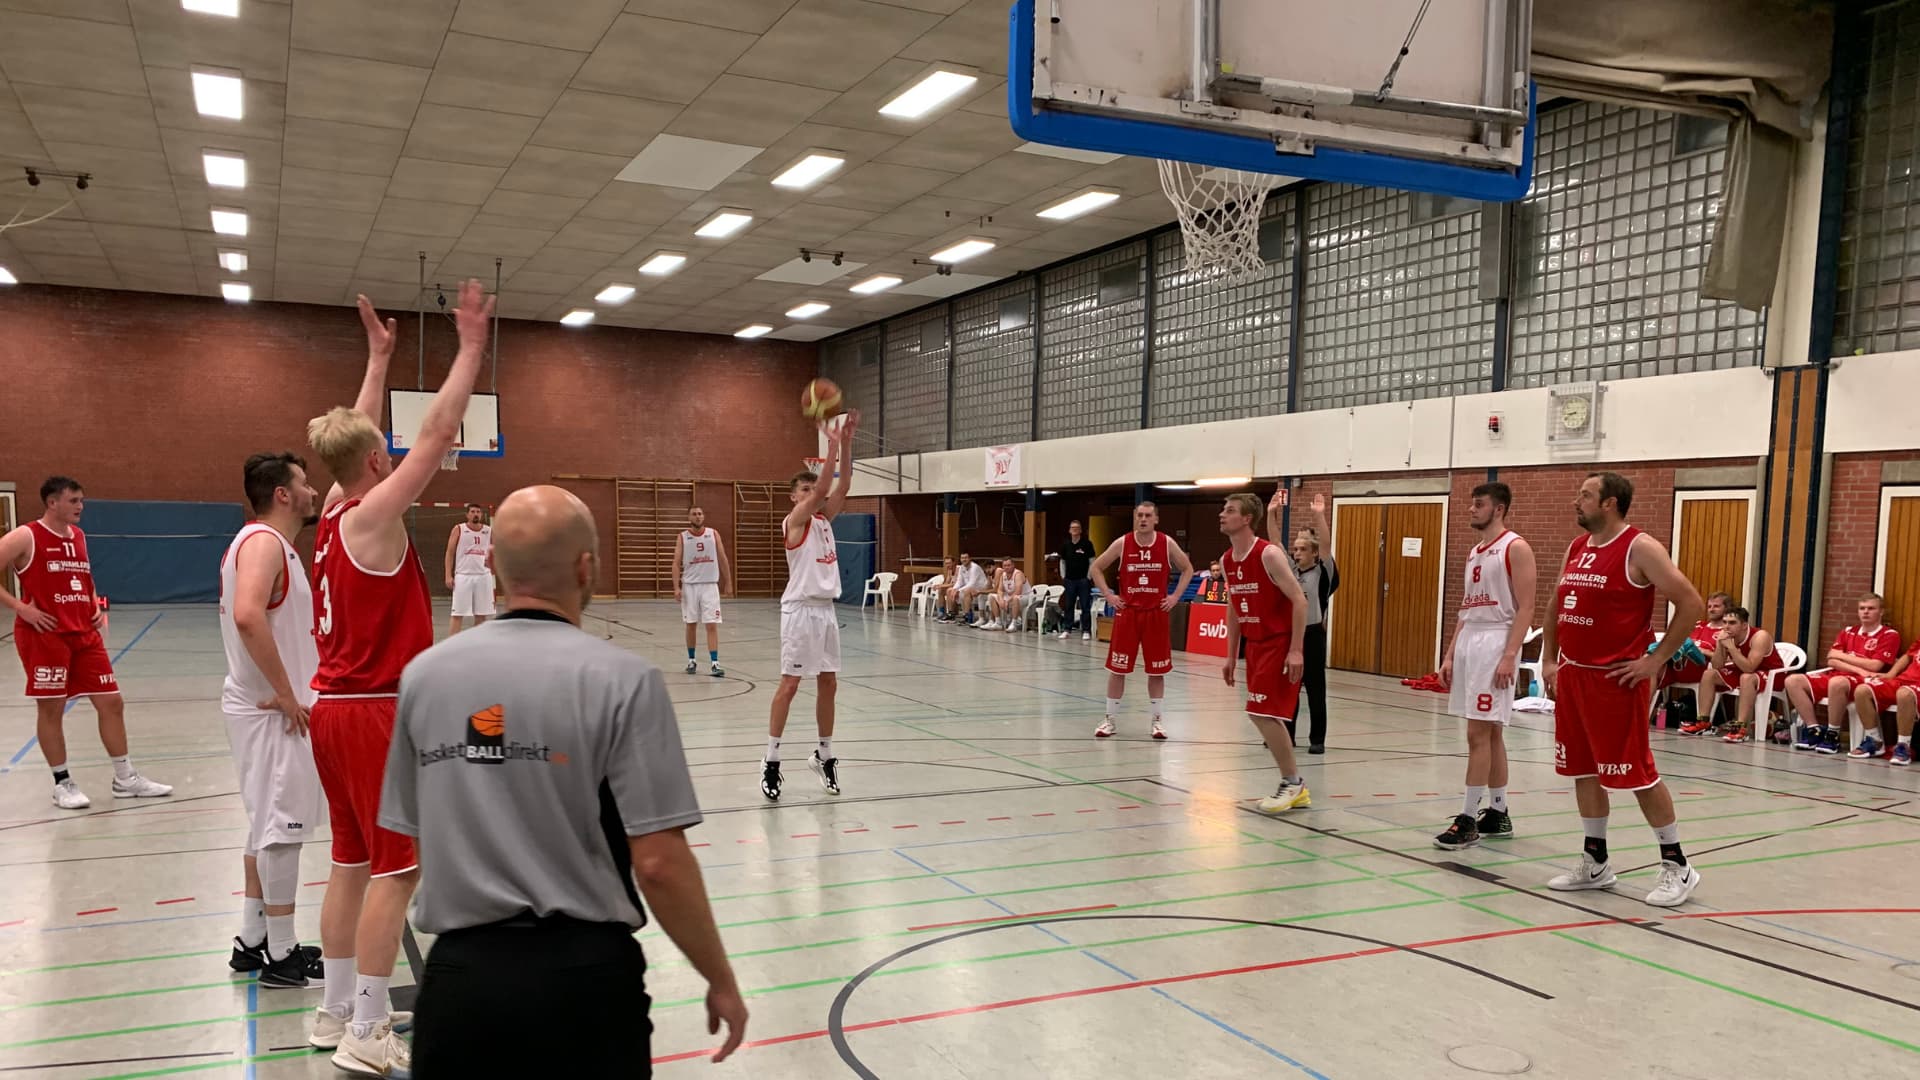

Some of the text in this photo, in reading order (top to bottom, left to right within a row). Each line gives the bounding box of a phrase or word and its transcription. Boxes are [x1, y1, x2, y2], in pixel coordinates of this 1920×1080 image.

[62, 541, 76, 557] 11
[696, 542, 705, 552] 9
[1139, 550, 1152, 561] 14
[1577, 552, 1597, 569] 12
[1237, 566, 1244, 581] 6
[1473, 565, 1482, 584] 8
[1566, 572, 1608, 584] WAHLERS
[319, 573, 333, 635] 3
[1199, 619, 1228, 639] swb
[1477, 693, 1493, 713] 8
